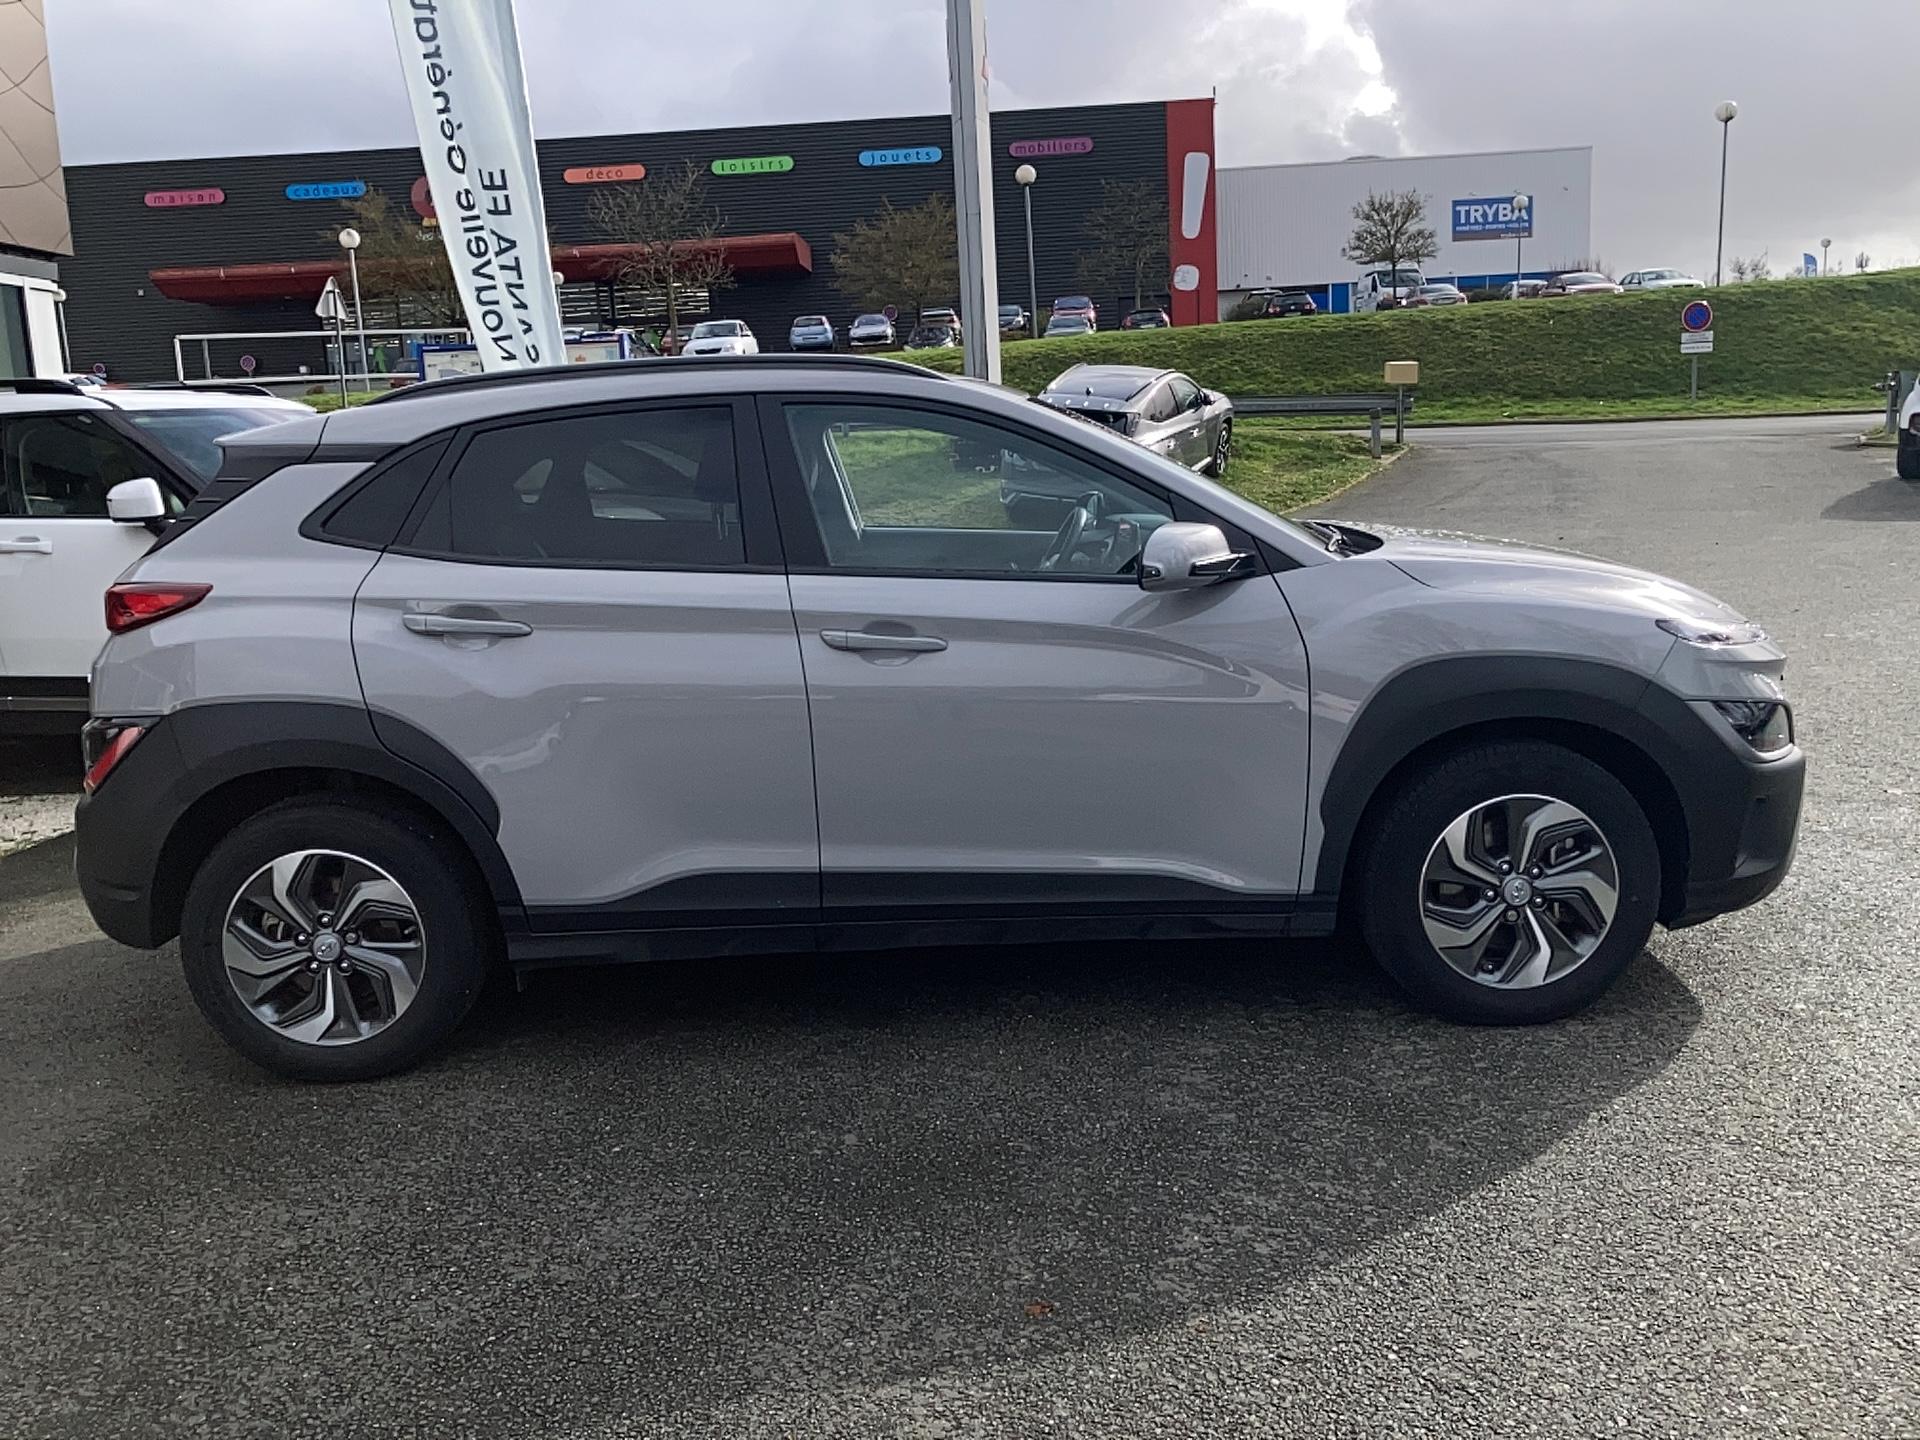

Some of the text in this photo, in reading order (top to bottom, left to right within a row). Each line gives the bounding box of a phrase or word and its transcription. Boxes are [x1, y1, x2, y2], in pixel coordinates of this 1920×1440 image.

[1015, 141, 1087, 154] mobiliers
[870, 150, 932, 165] jouets
[721, 160, 784, 172] loisirs
[294, 184, 359, 197] cadeaux
[153, 193, 216, 204] maison
